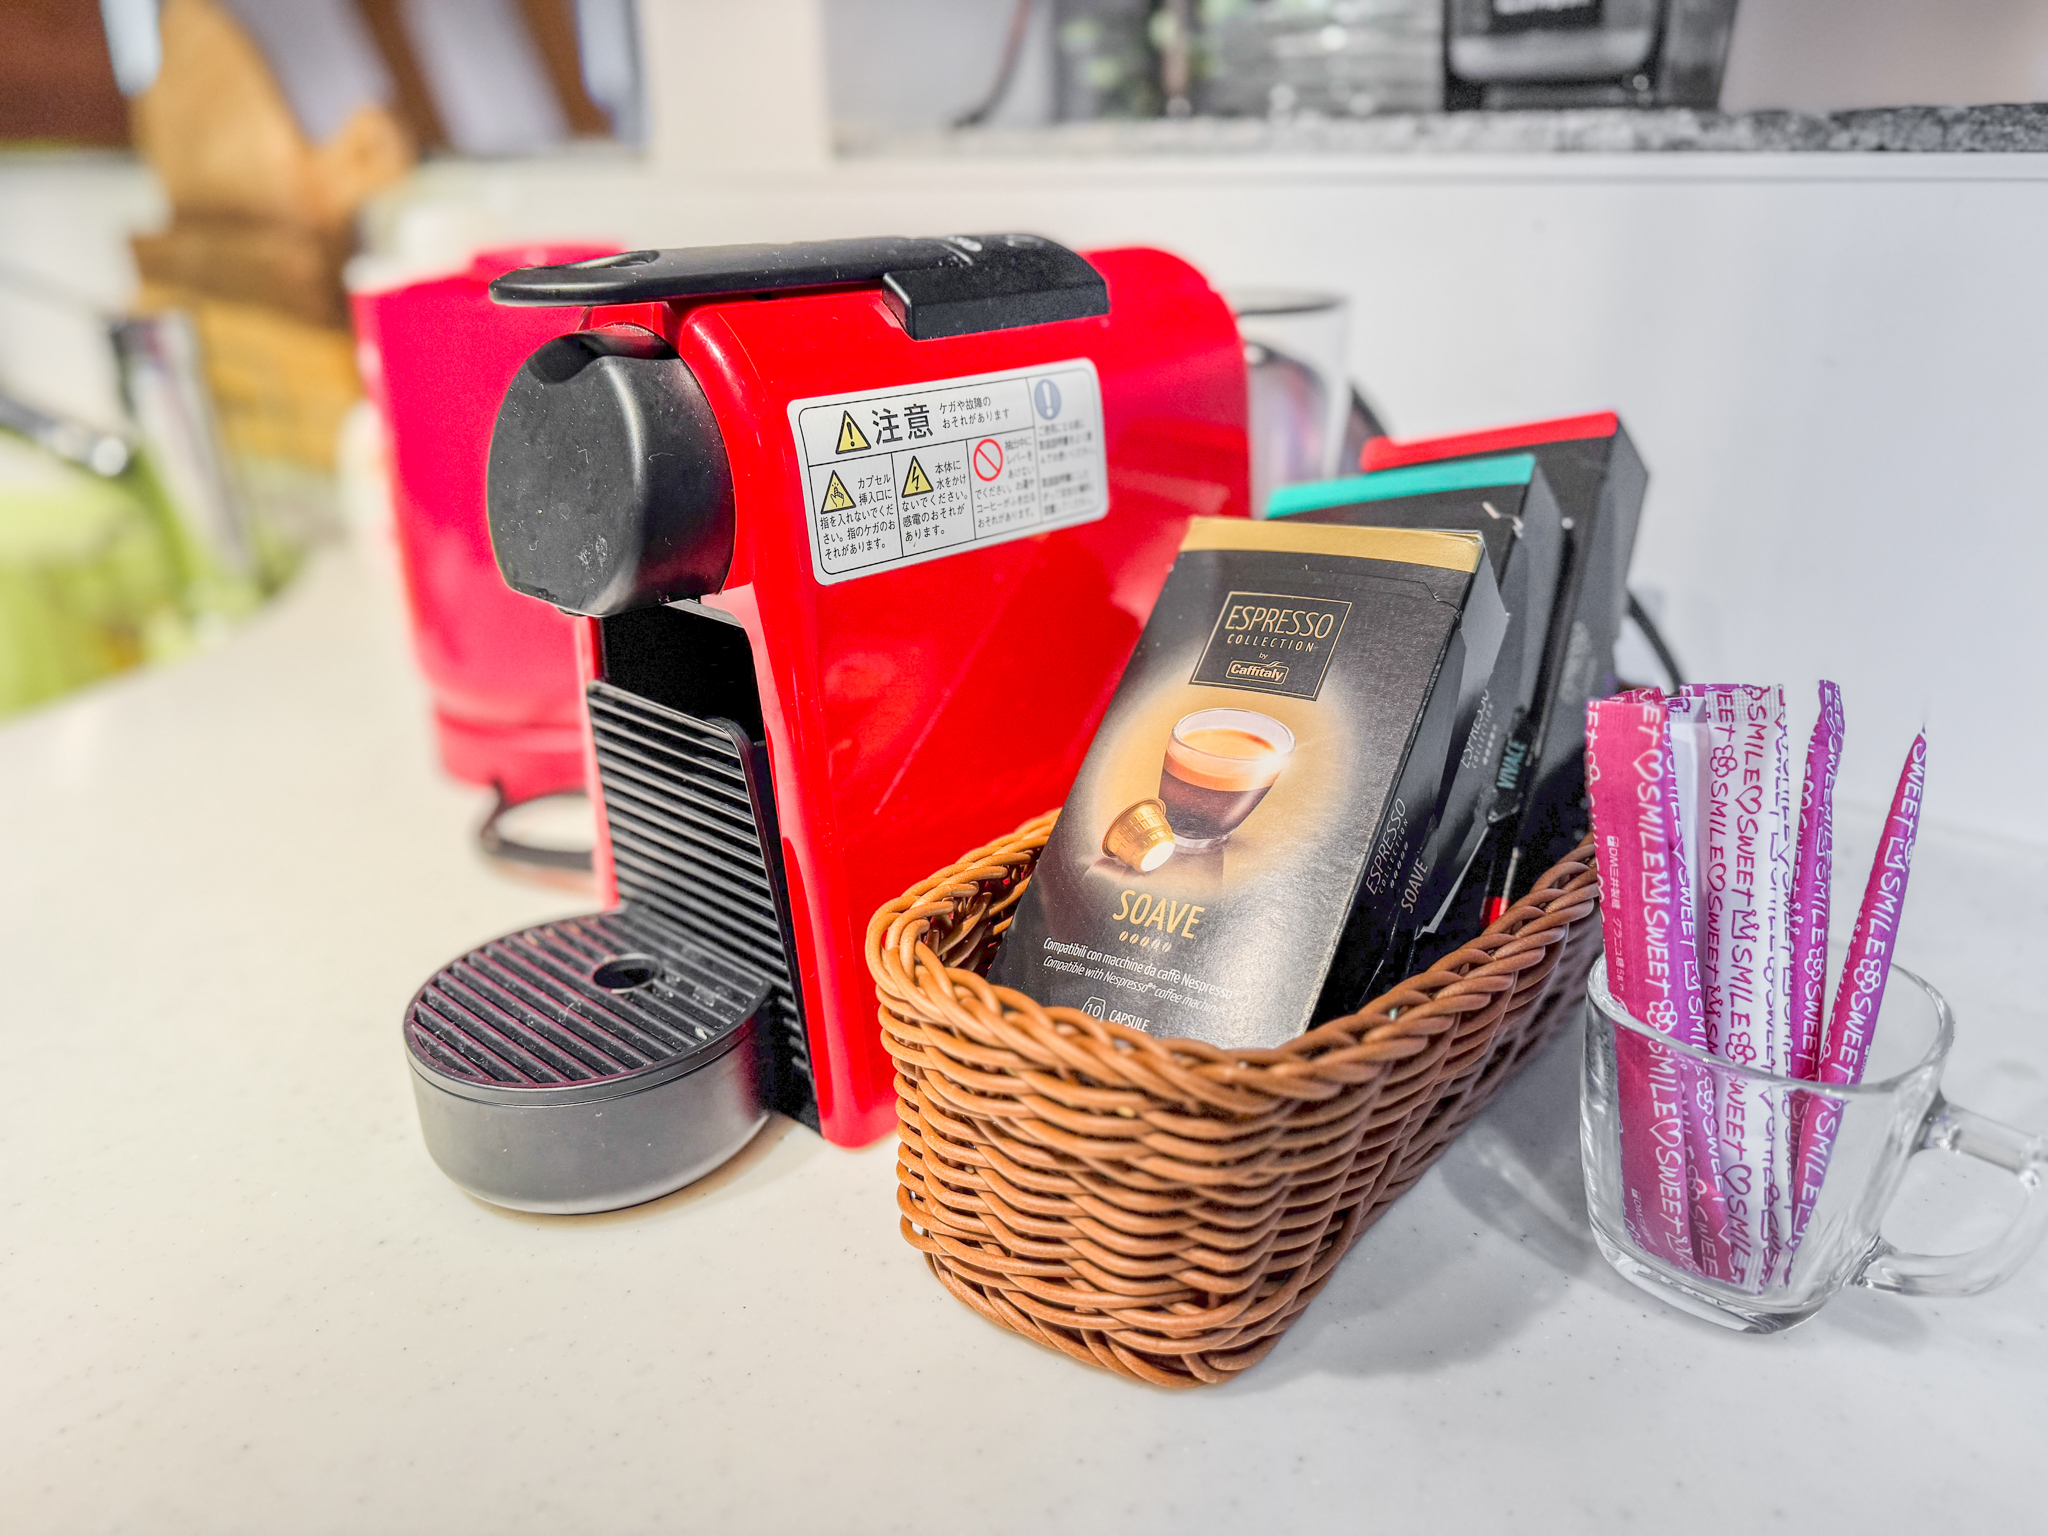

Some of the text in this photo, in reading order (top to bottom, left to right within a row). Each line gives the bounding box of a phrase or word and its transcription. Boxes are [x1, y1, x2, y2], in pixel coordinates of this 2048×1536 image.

[872, 403, 933, 445] 注意
[940, 397, 991, 414] ケガや故障の
[942, 408, 1010, 429] おそれがあります
[935, 460, 961, 475] 本体に
[936, 474, 967, 490] 水をかけ
[820, 505, 894, 530] 指を入れないでくだ
[859, 489, 892, 506] 挿入口に
[902, 490, 968, 512] ないでください。
[902, 503, 965, 528] 感電のおそれが
[822, 519, 896, 545] さい。指のケガのお
[825, 538, 886, 561] それがあります。
[905, 524, 945, 543] あります。
[1224, 605, 1335, 639] ESPRESSO
[1227, 634, 1315, 653] COLLECTION
[1230, 663, 1285, 682] Caffitaly
[1258, 652, 1269, 660] by
[1743, 703, 1768, 786] SMILE
[1637, 781, 1666, 870] SMILE
[1708, 780, 1729, 863] SMILE
[1366, 797, 1406, 896] ESPRESSO
[1379, 818, 1409, 895] COLLECTION
[1732, 814, 1759, 908] SWEET
[1400, 858, 1428, 914] SOAVE
[1811, 860, 1828, 945] SMILE
[1112, 889, 1206, 939] SOAVE
[1642, 905, 1673, 998] SWEET
[1705, 892, 1724, 982] SWEET
[1043, 937, 1233, 999] Compatibili con macchine da caffè Nespresso
[1043, 955, 1084, 976] Compatible
[1084, 967, 1103, 981] with
[1154, 987, 1182, 1003] coffee
[1729, 944, 1754, 1036] SMILE
[1801, 741, 1926, 1202] SWEET SMILE SWEET SMILE
[1087, 1002, 1150, 1033] 10 CAPSULE
[1796, 980, 1822, 1071] SWEET
[1655, 1146, 1685, 1235] SWEET
